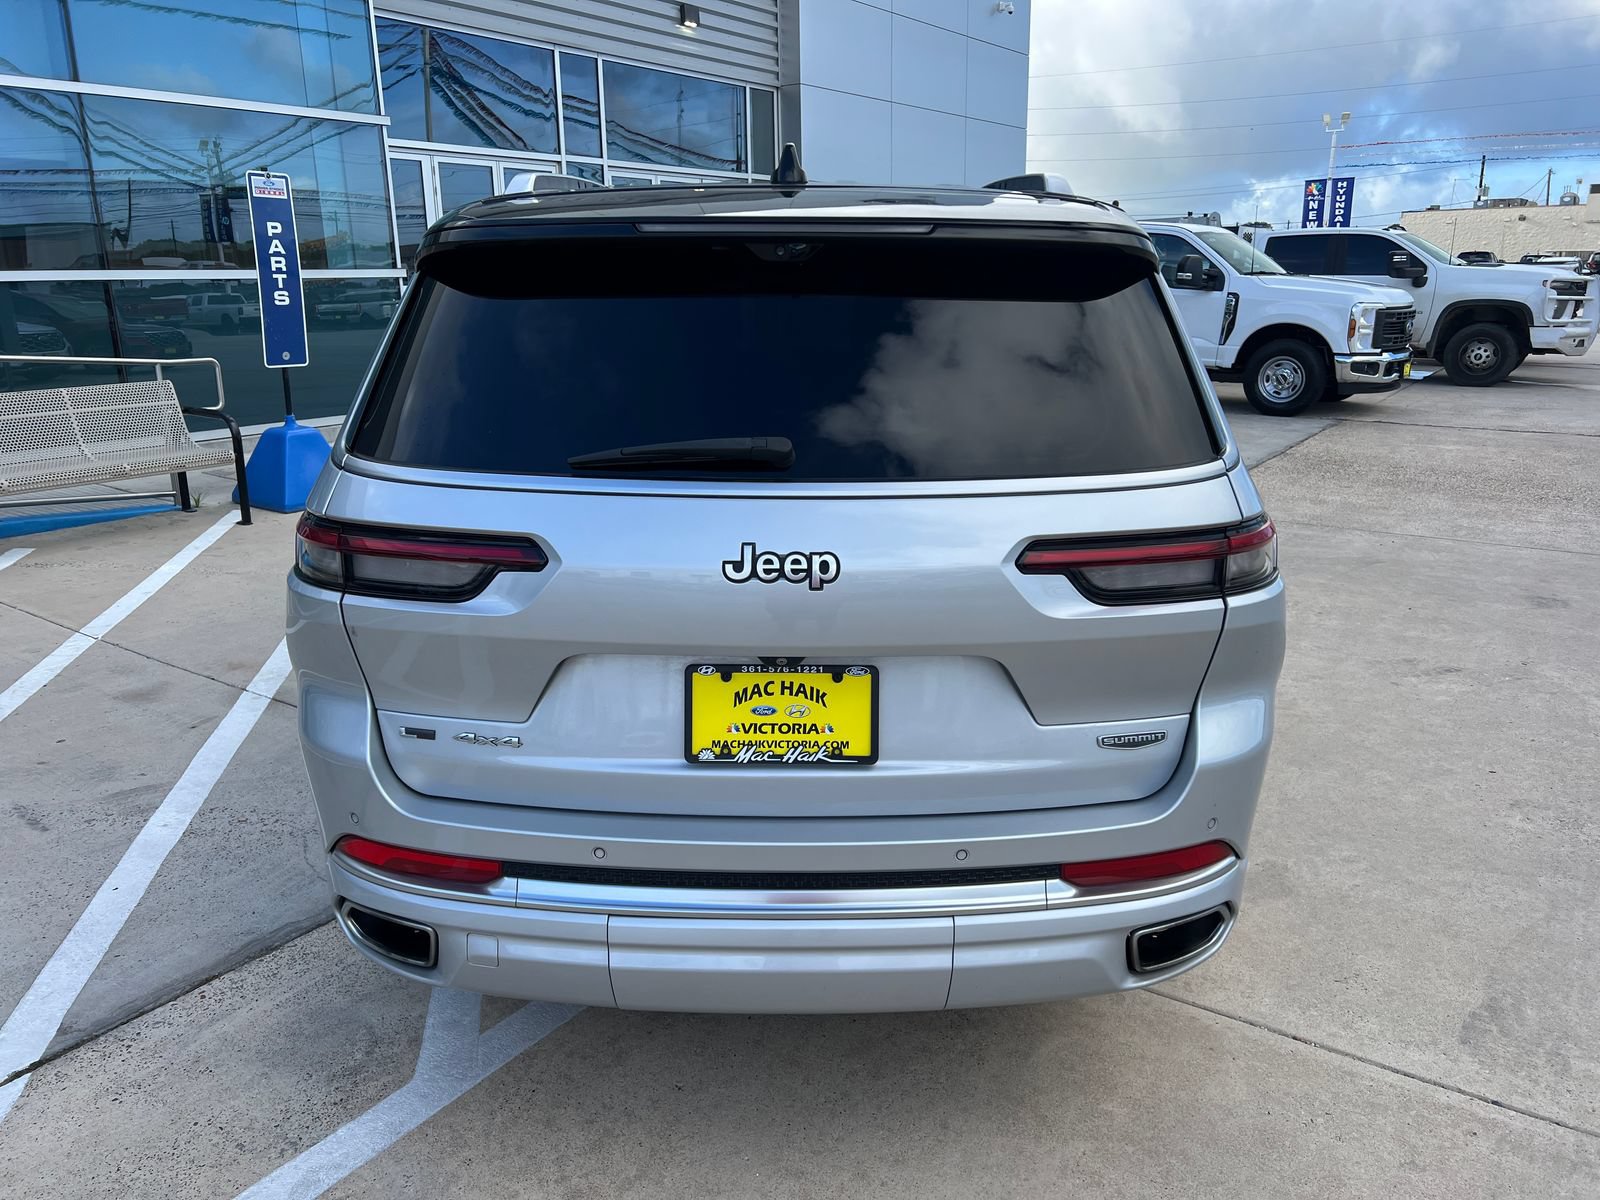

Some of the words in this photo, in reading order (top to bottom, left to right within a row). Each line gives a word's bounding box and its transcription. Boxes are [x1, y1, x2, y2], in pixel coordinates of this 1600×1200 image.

[1306, 200, 1319, 228] NEW
[1334, 181, 1348, 228] HYUNDAI
[266, 221, 290, 306] PARTS
[722, 542, 841, 591] Jeep
[741, 665, 824, 673] 361-576-1221
[733, 680, 775, 708] MAC
[780, 680, 828, 708] HAIK
[754, 707, 774, 715] Ford
[741, 723, 820, 735] VICTORIA
[711, 739, 850, 749] MACHAIKVICTORIACOM
[734, 744, 776, 763] Mac
[781, 744, 832, 763] Haik
